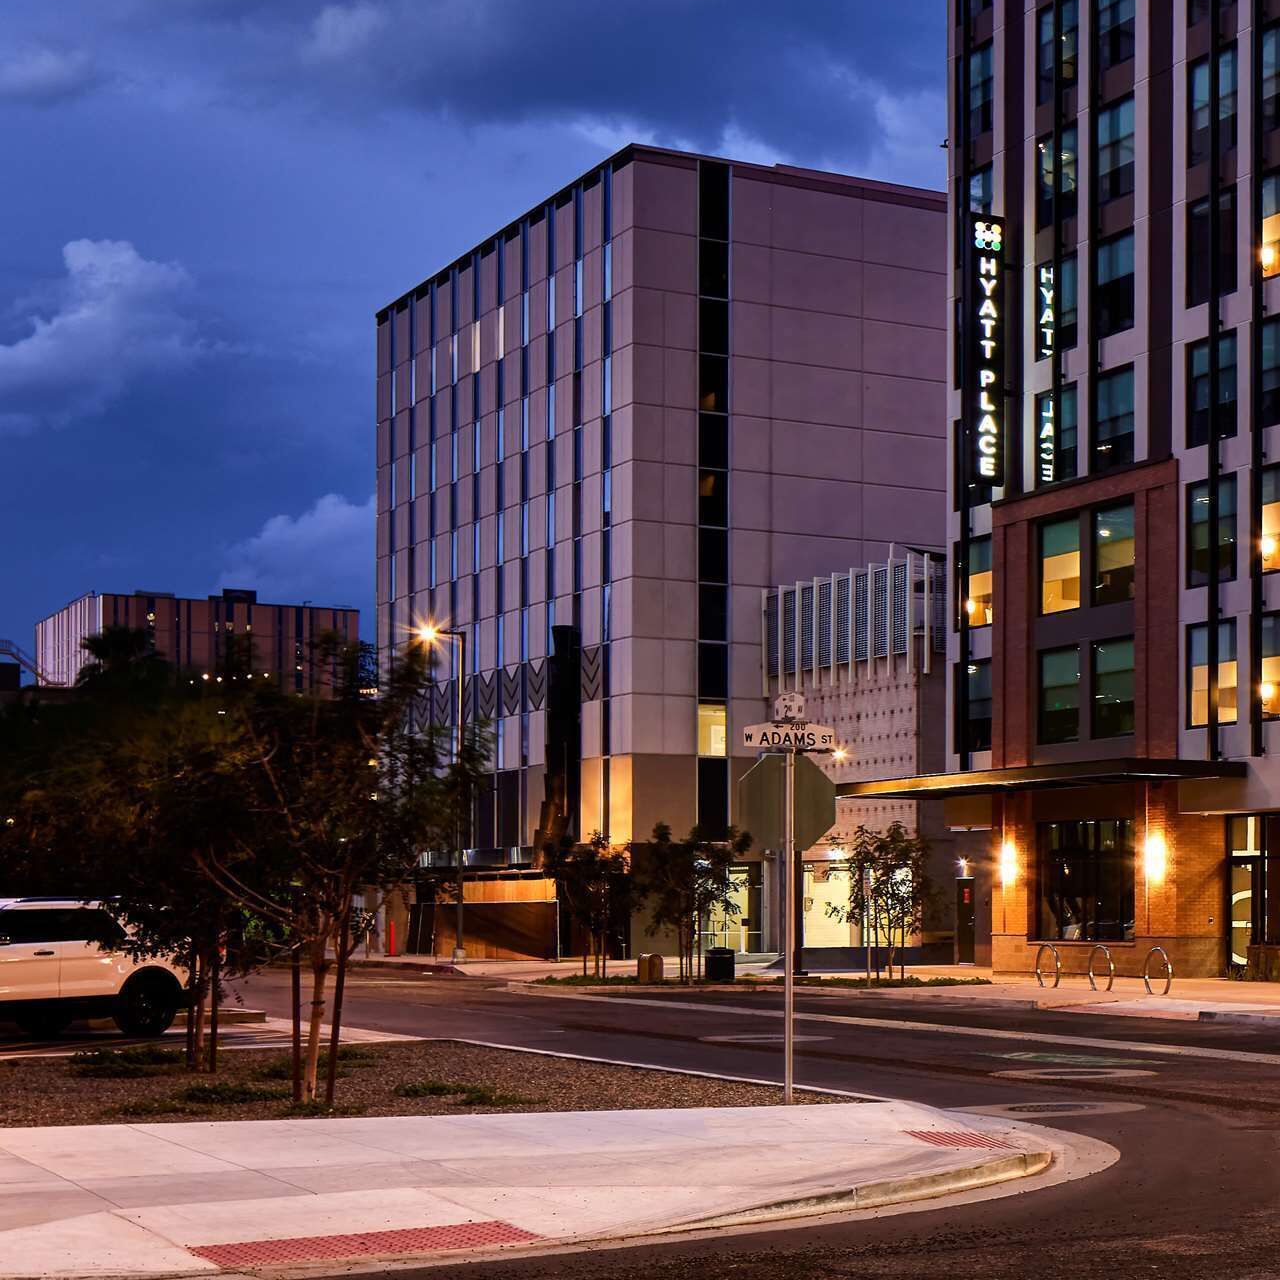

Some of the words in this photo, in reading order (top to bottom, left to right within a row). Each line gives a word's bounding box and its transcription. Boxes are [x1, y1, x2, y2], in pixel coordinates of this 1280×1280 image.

[979, 256, 997, 359] HYATT
[979, 369, 997, 477] PLACE
[745, 733, 753, 743] W
[759, 732, 816, 746] ADAMS
[821, 734, 833, 744] ST
[790, 723, 806, 731] 200
